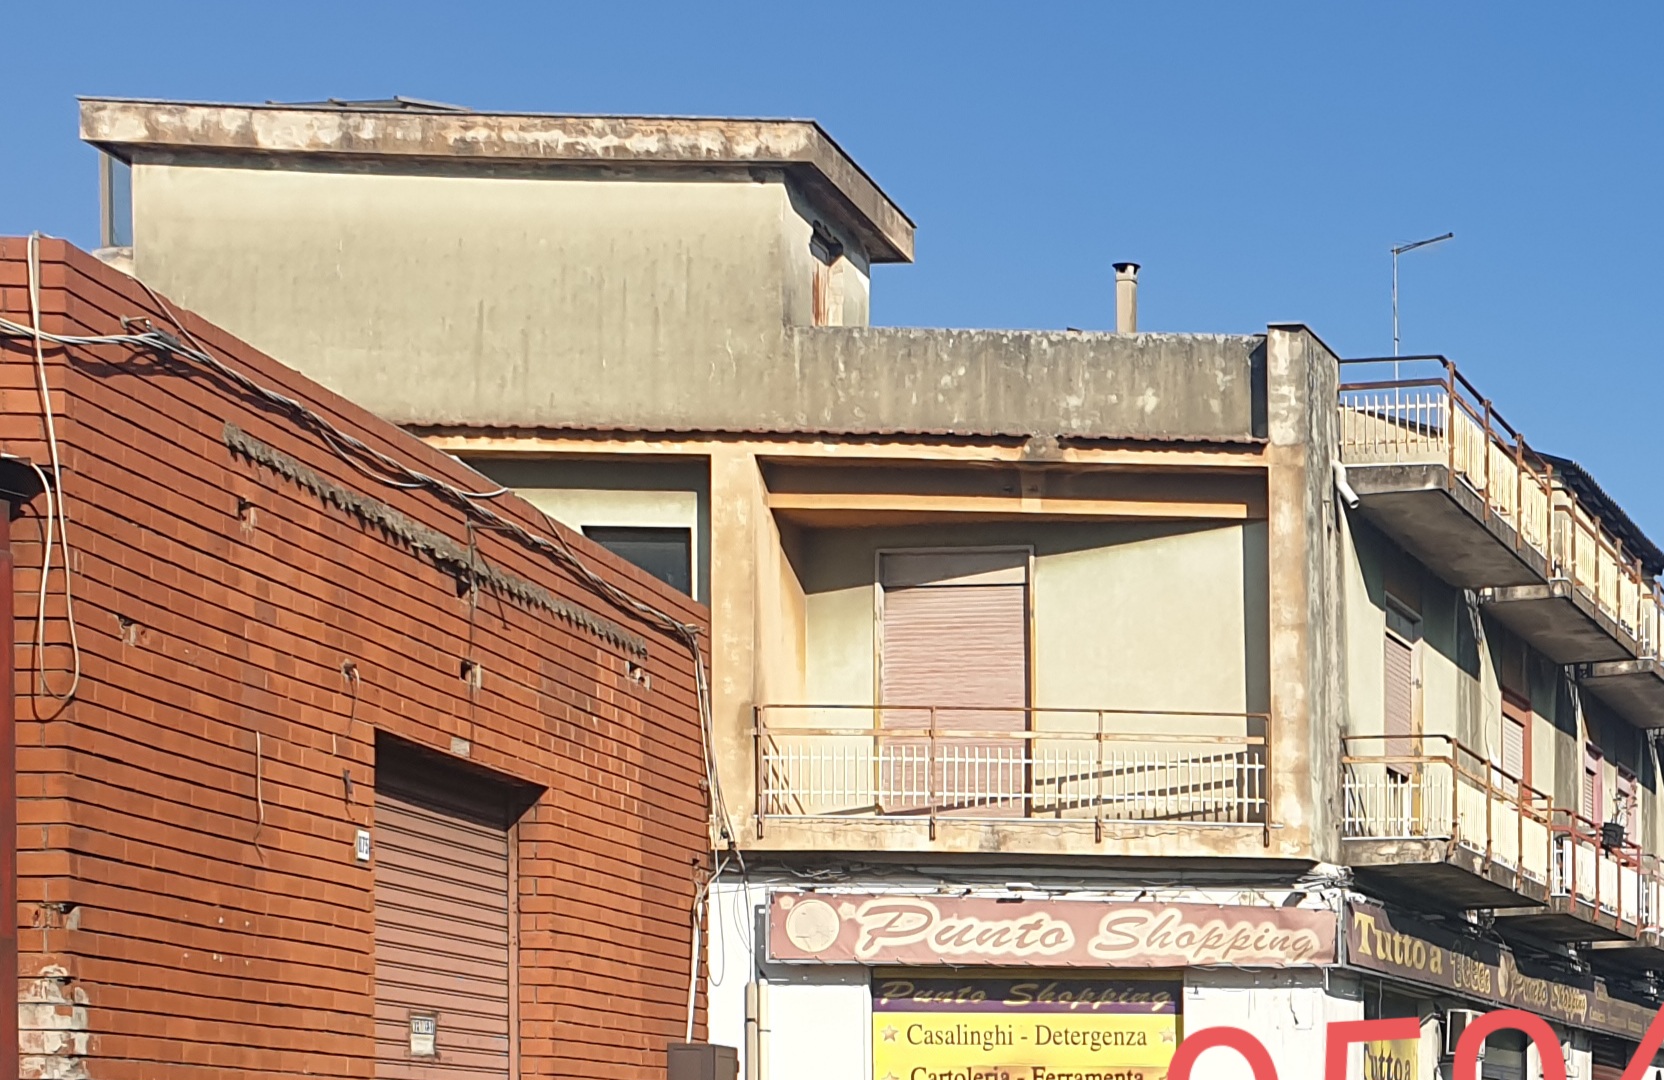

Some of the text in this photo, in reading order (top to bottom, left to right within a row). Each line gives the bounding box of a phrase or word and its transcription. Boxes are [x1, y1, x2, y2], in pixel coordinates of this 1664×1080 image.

[858, 903, 1315, 961] Punto Shopping
[1354, 911, 1426, 971] Tutto
[1430, 945, 1443, 975] a
[880, 981, 1172, 1011] Punto Shopping
[906, 1024, 1014, 1050] Casalinghi
[1035, 1025, 1147, 1051] Detergenza
